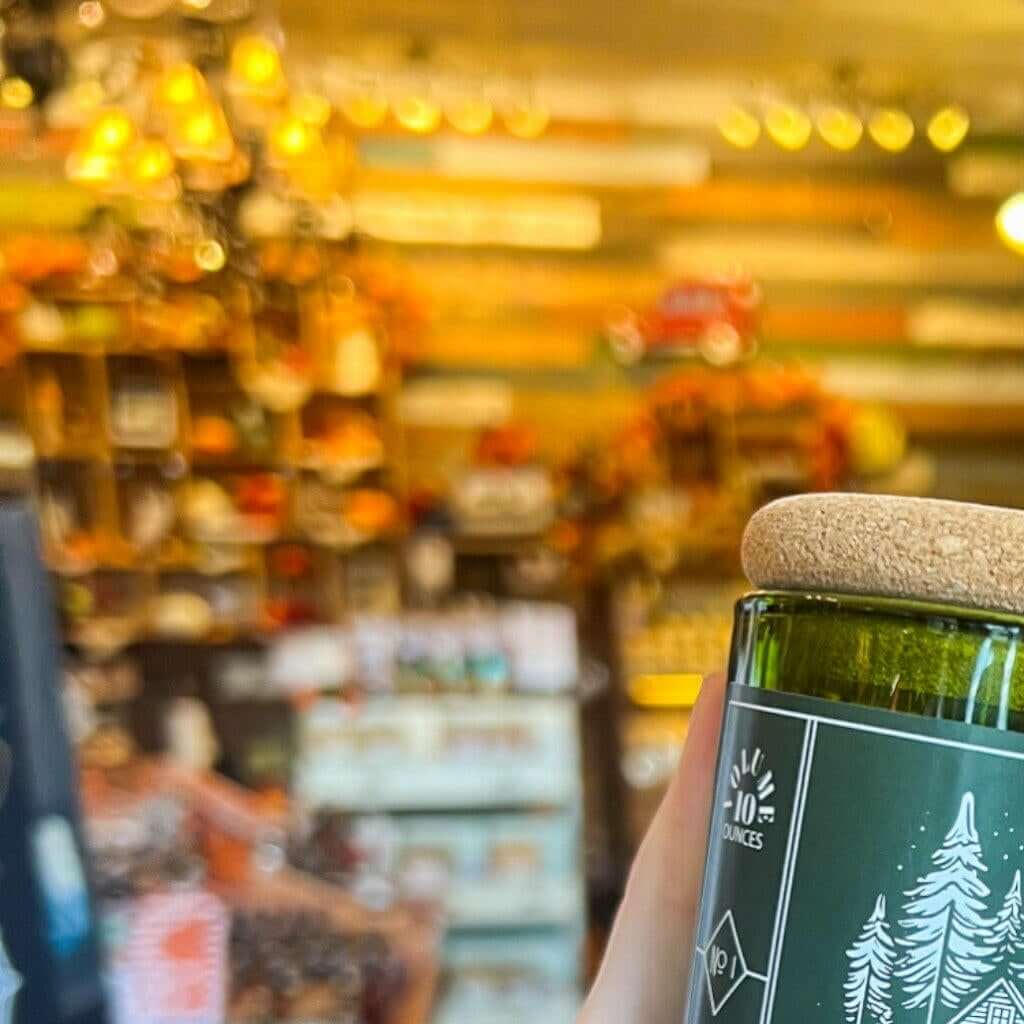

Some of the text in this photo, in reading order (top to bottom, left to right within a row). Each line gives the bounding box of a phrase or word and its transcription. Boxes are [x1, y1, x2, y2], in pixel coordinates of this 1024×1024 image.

[723, 747, 775, 824] OLUME
[734, 790, 757, 826] 10
[723, 823, 764, 850] OUNCES
